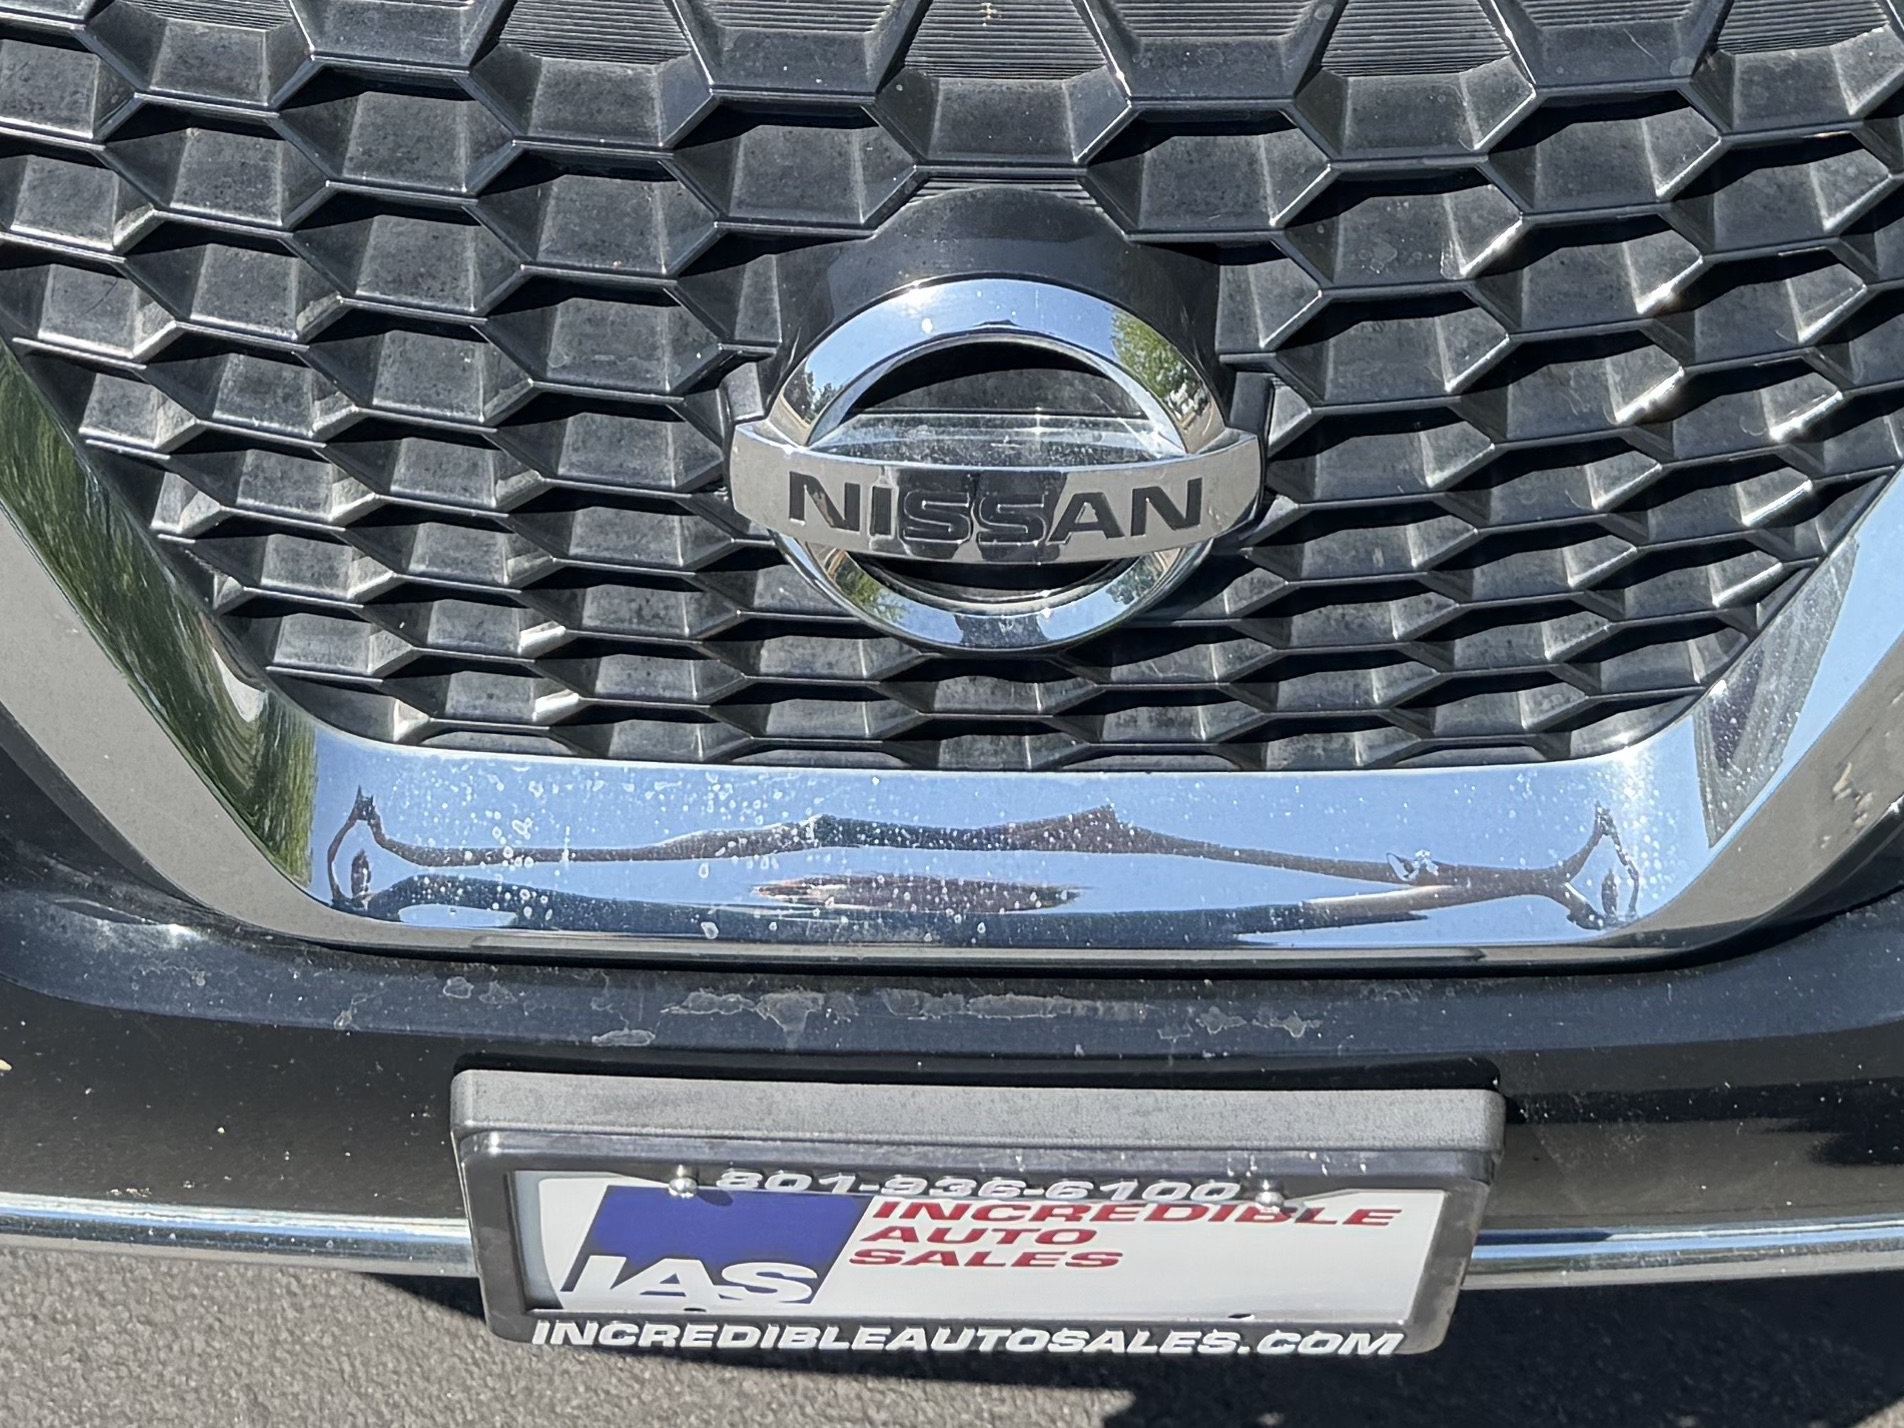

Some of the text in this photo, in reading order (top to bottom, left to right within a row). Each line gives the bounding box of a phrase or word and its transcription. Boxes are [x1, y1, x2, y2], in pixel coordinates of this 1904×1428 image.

[788, 470, 1203, 545] NISSAN
[716, 1169, 1240, 1204] 801-936-6100
[872, 1200, 1403, 1227] INCREDIBLE
[859, 1225, 1098, 1245] AUTO
[848, 1248, 1124, 1268] SALES
[572, 1255, 819, 1305] IAS
[531, 1319, 1404, 1356] INCREDIBLEAUTOSALES.COM
